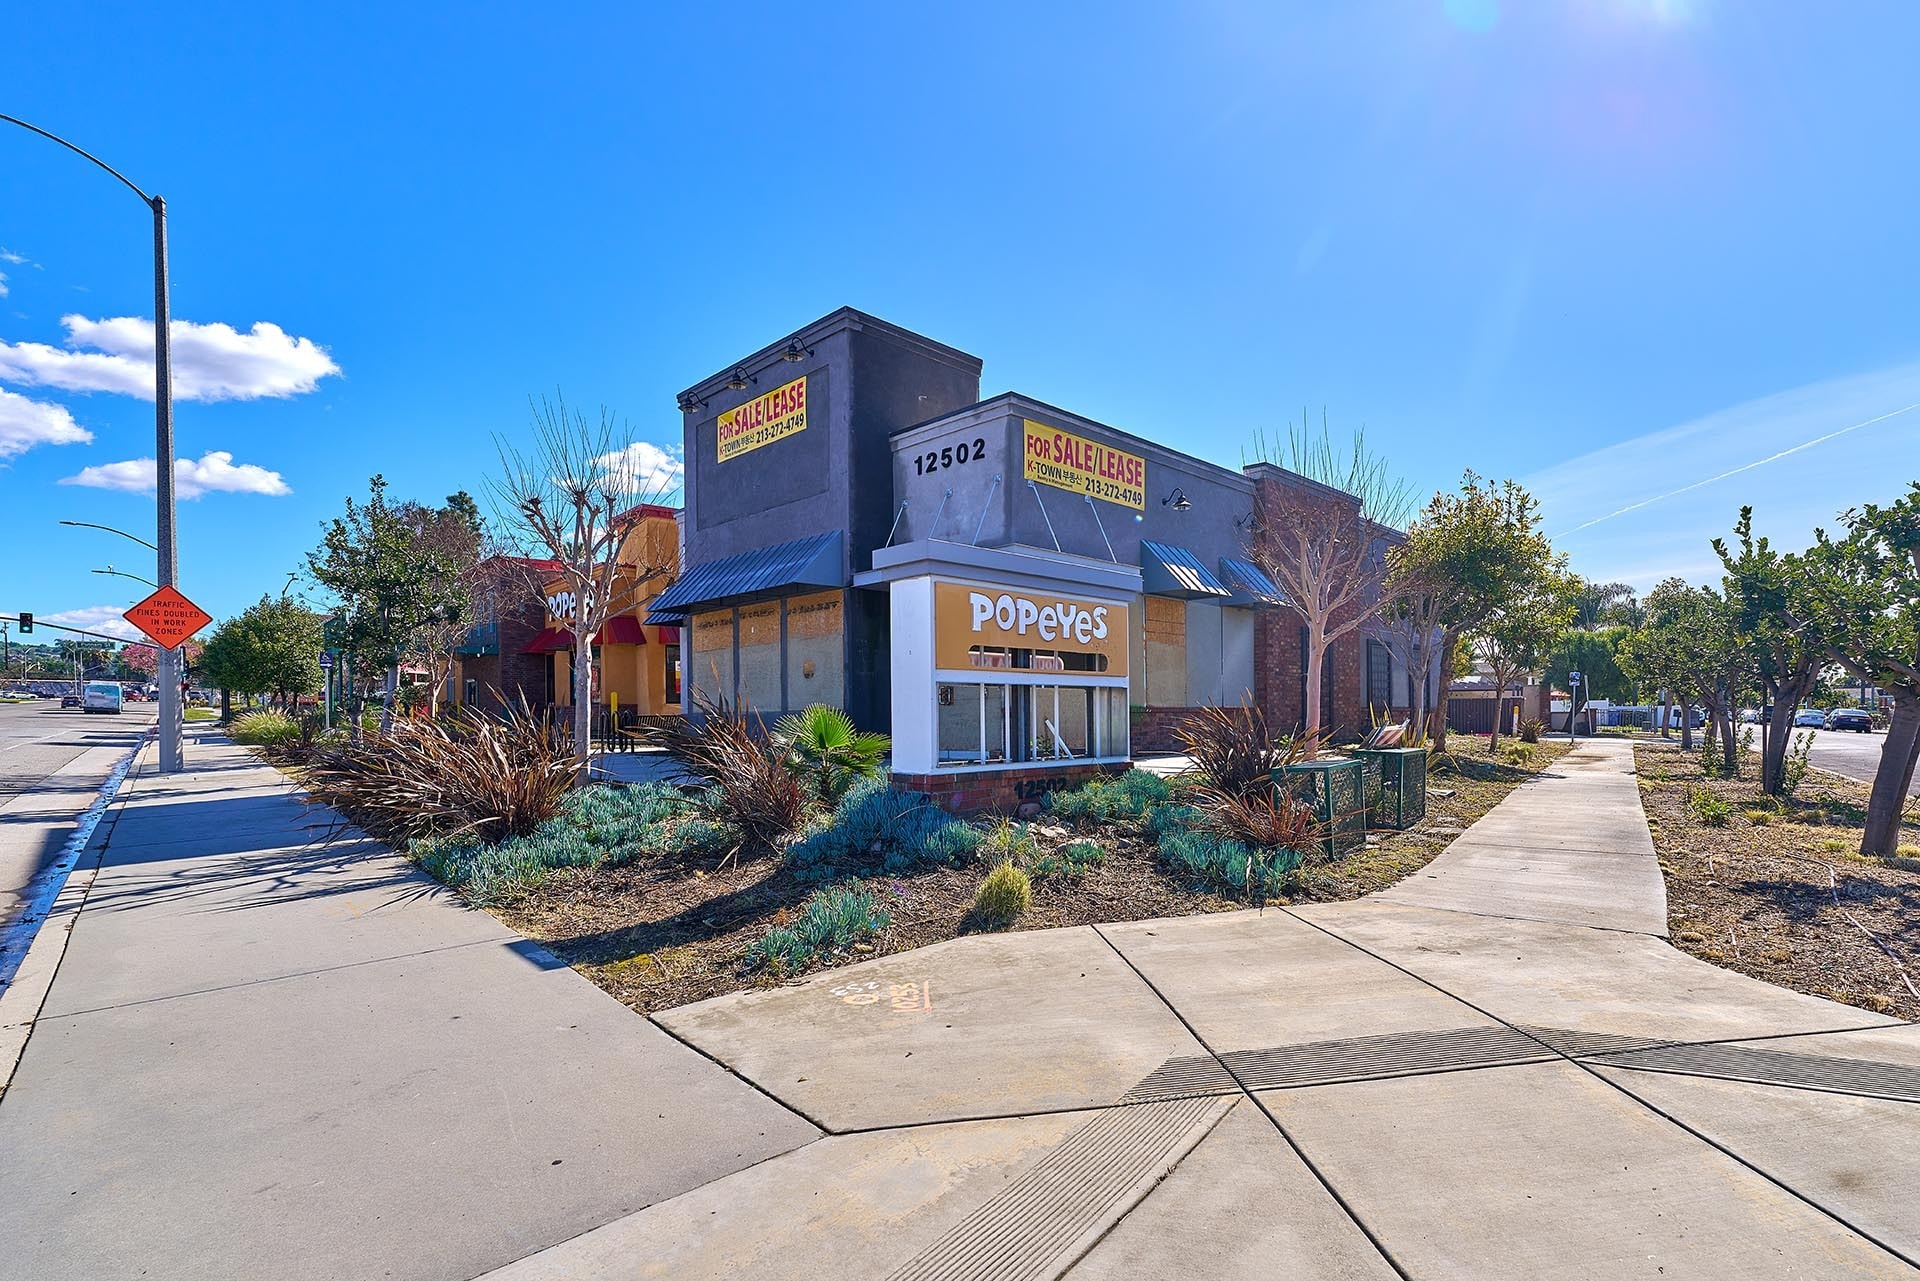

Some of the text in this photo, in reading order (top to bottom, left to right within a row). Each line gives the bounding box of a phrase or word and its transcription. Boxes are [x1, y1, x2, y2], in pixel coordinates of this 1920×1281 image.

[719, 381, 804, 442] FOR SALE/LEASE
[756, 413, 805, 444] 213-272-4749
[914, 438, 986, 476] 12502
[1027, 433, 1143, 489] FOR SALE/LEASE
[1027, 460, 1142, 505] K-TOWN 부동산 213-272-4749
[136, 609, 200, 618] FINES DOUBLED
[152, 600, 185, 609] TRAFFIC
[155, 627, 183, 635] ZONES
